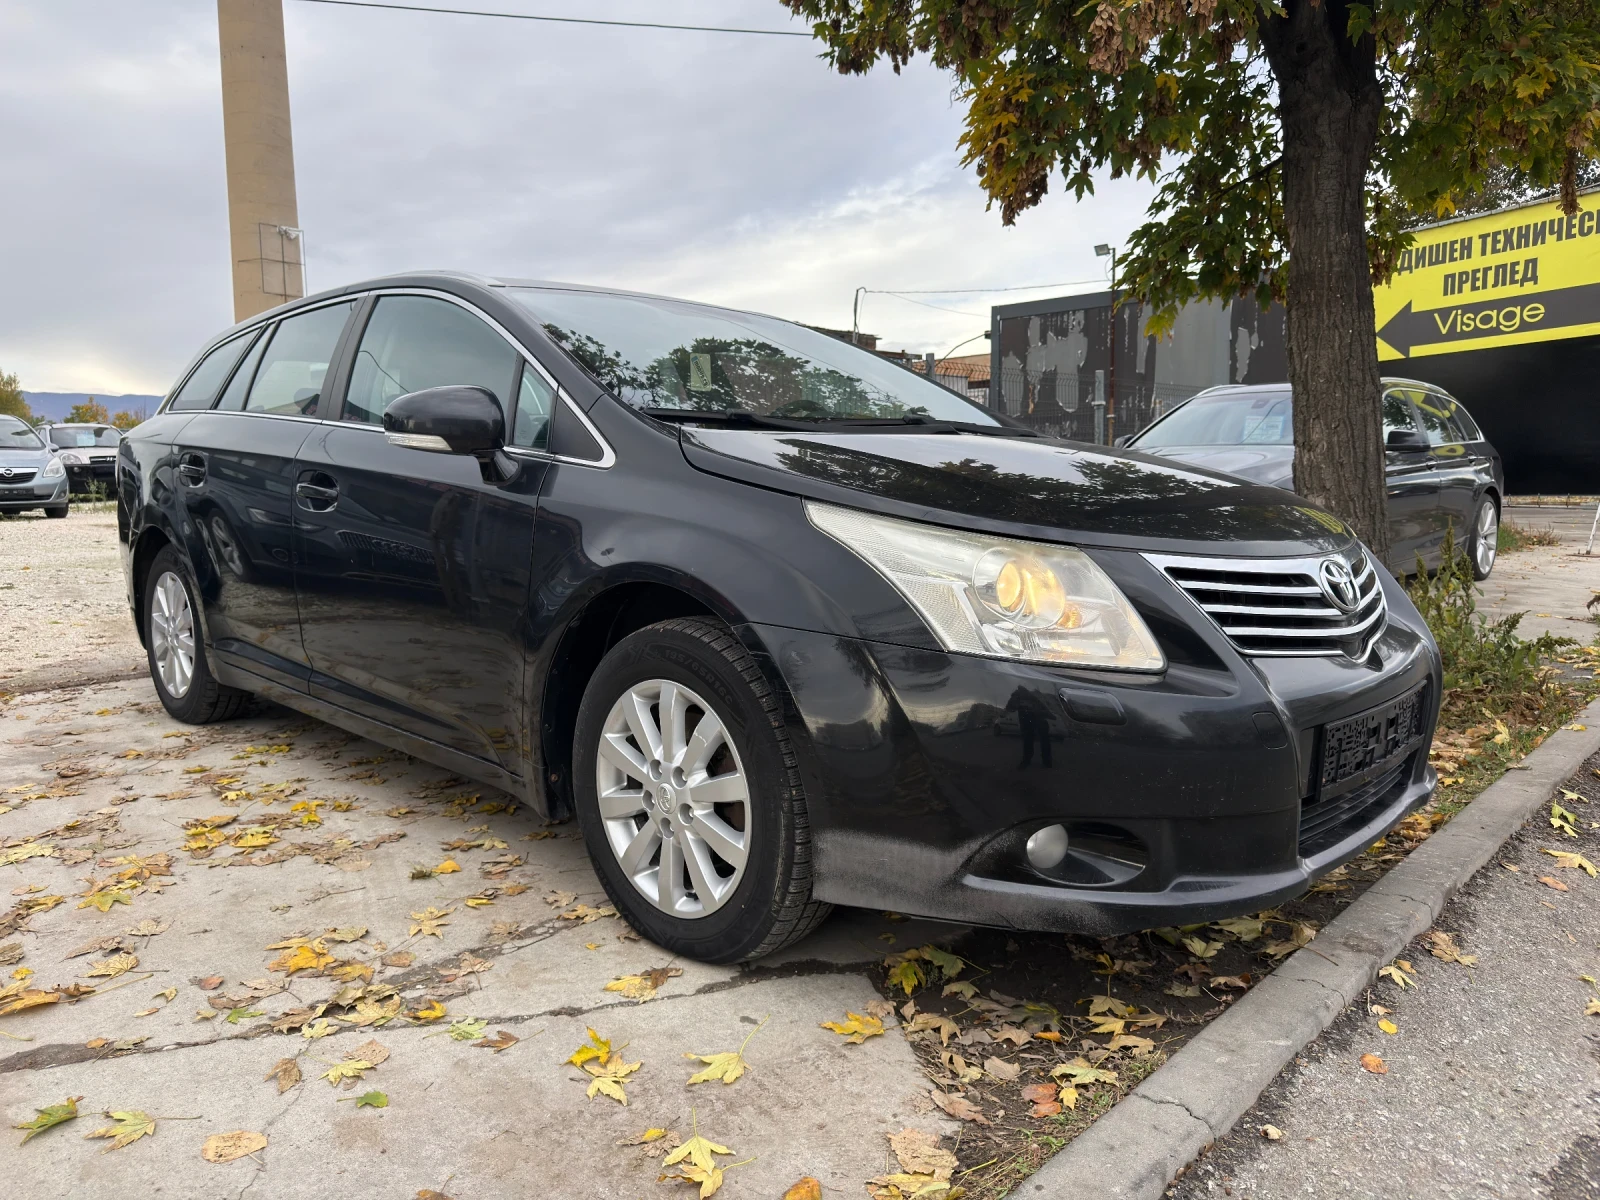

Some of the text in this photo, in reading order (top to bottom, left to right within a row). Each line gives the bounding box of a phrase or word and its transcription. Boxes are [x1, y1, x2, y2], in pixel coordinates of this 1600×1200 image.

[1398, 209, 1600, 276] ДИШЕН ТЕХНИЧЕС
[1443, 257, 1538, 297] ПРЕГЛЕД
[1433, 303, 1546, 335] Visage
